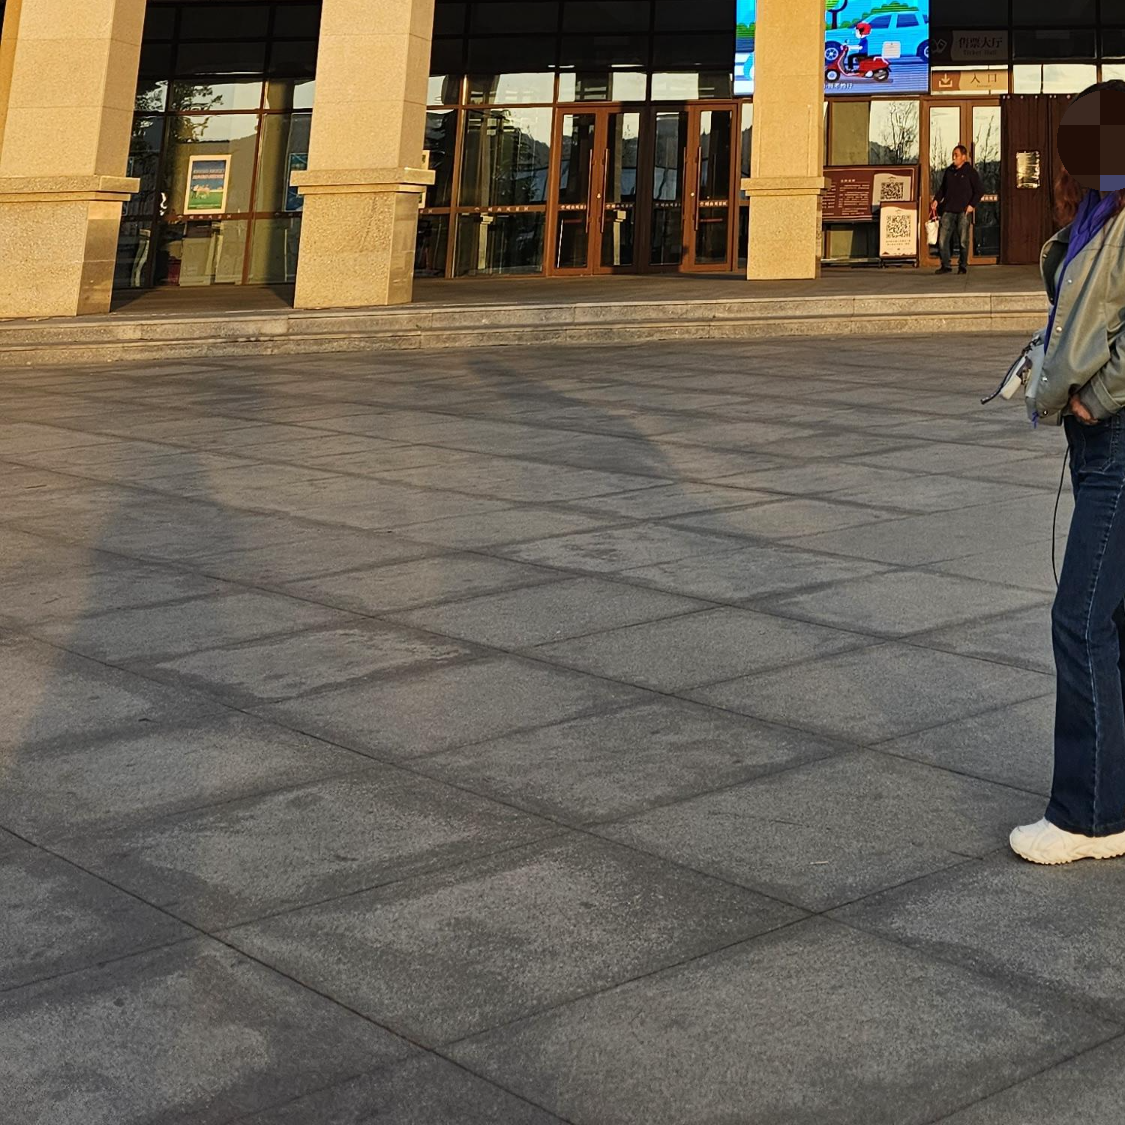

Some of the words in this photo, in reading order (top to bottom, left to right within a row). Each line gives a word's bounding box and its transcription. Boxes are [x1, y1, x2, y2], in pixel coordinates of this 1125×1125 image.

[959, 36, 1003, 49] 售票大厅
[970, 73, 997, 84] 入口
